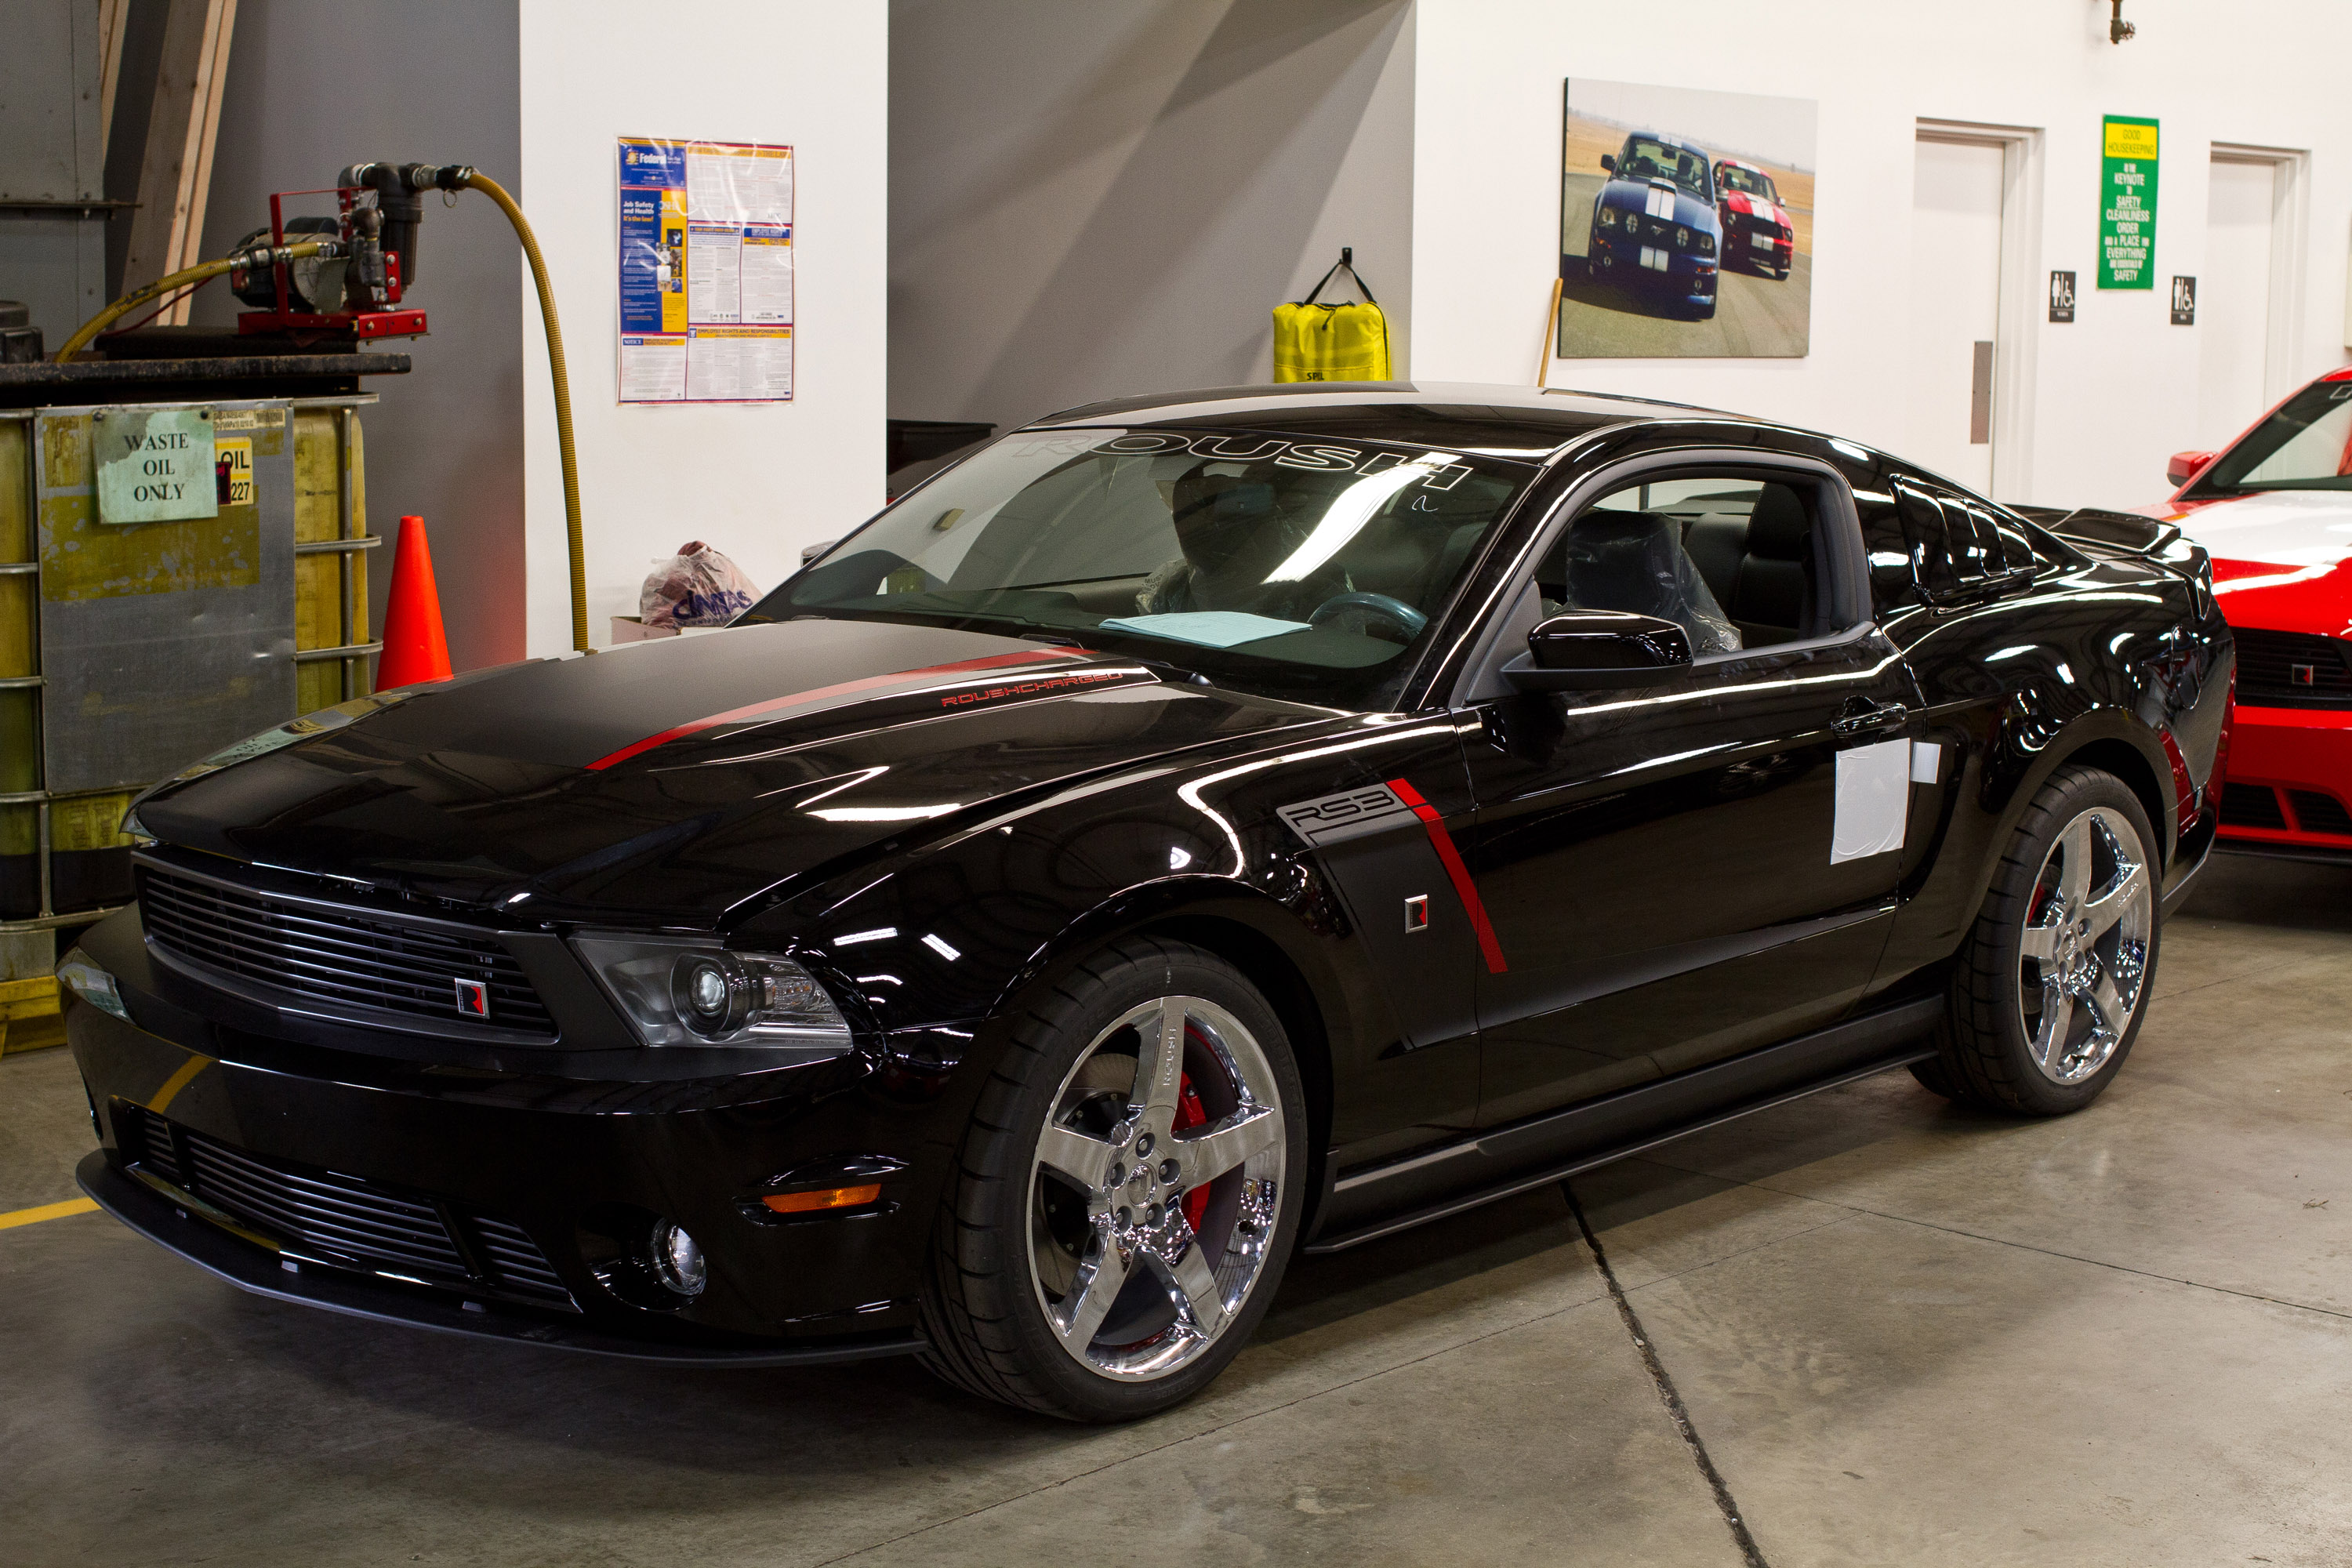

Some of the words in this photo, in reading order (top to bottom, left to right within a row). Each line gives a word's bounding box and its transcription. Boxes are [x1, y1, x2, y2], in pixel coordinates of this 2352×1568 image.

[2122, 129, 2141, 140] GOOD
[2107, 142, 2155, 155] HOUSEKEEPING
[639, 153, 667, 164] Federal
[2114, 172, 2145, 187] KEYNOTE
[2116, 195, 2142, 208] SAFETY
[2106, 209, 2151, 223] CLEANLINESS
[2116, 222, 2140, 234] ORDER
[2119, 234, 2140, 247] PLACE
[2106, 246, 2147, 260] EVERYTHING
[2114, 269, 2139, 281] SAFETY
[123, 432, 189, 451] WASTE
[143, 459, 176, 476] OIL
[220, 451, 251, 470] OIL
[1013, 433, 1474, 491] ROUSH
[133, 482, 185, 503] ONLY
[672, 589, 753, 619] CINTAS
[941, 672, 1124, 707] ROUSHCHARGED
[1284, 789, 1396, 828] RS3
[1162, 1029, 1177, 1086] ROUSH
